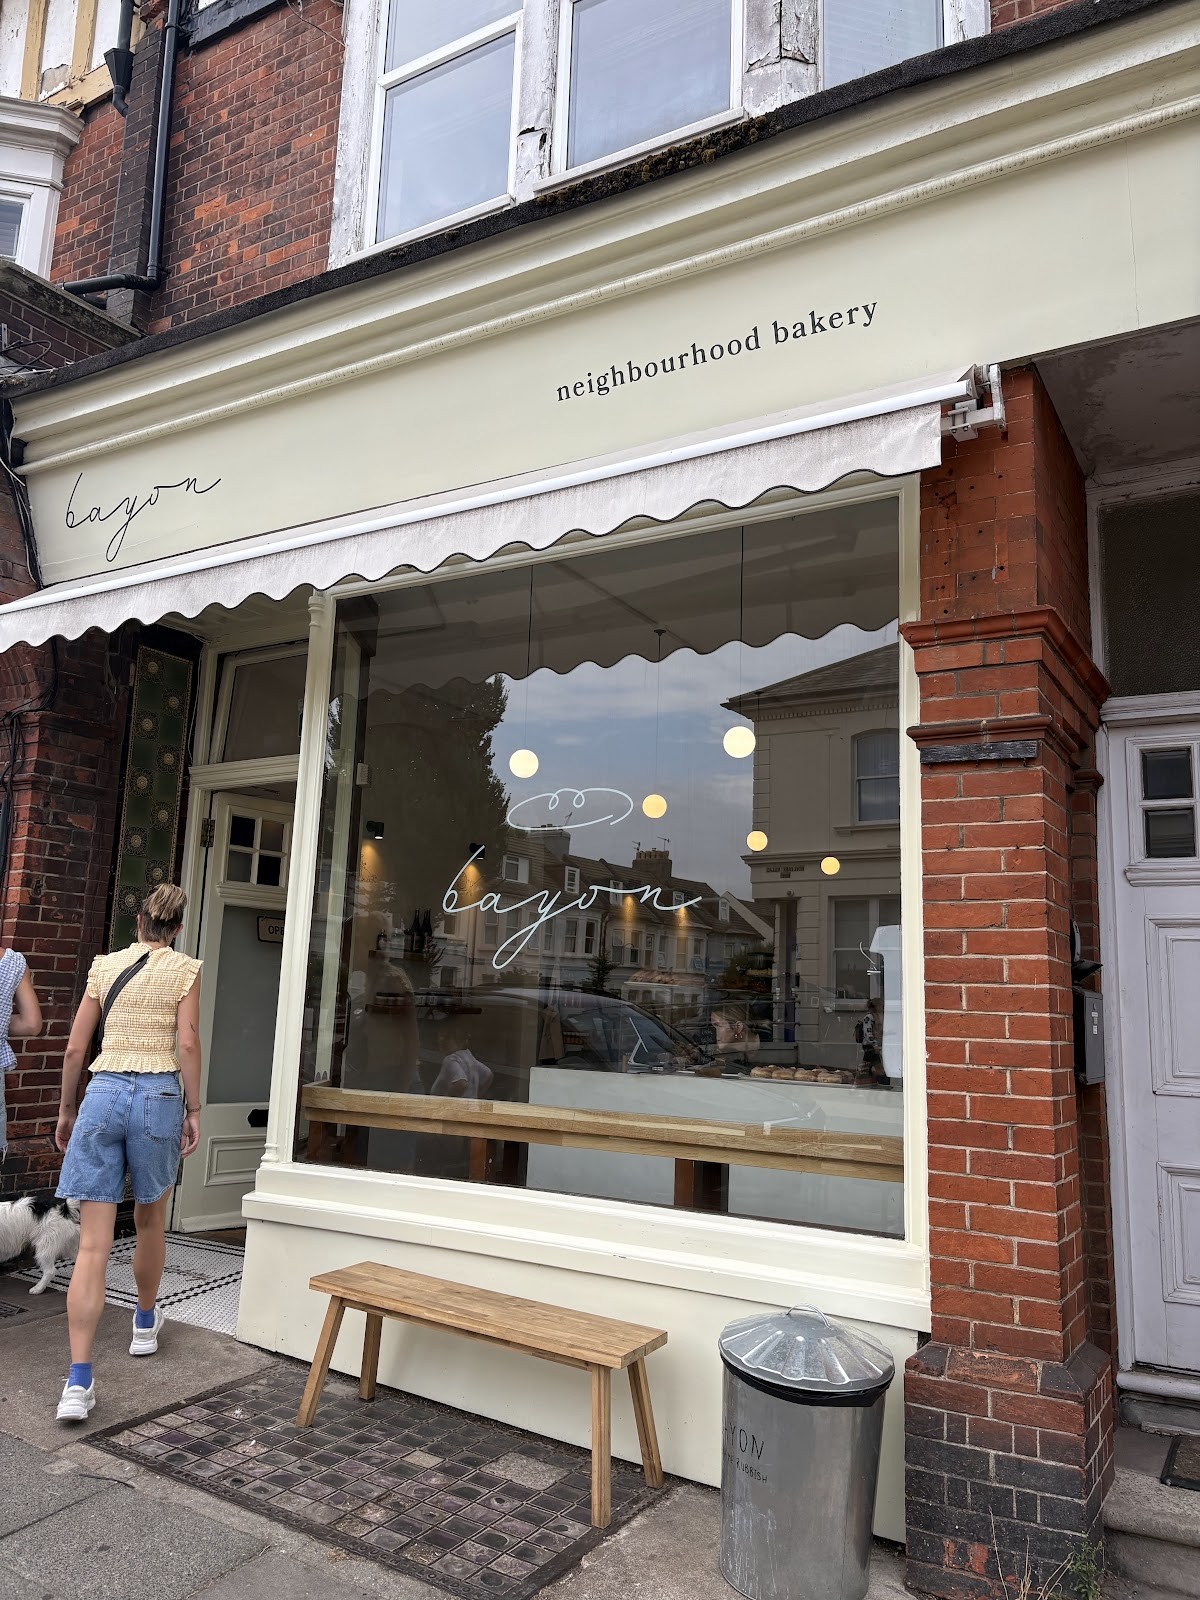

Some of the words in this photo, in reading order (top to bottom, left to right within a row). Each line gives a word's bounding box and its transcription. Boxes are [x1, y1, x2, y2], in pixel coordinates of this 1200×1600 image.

[556, 326, 762, 402] neighbourhood
[771, 301, 878, 345] bakery
[66, 472, 222, 562] bayon
[442, 844, 703, 970] bayon
[736, 1457, 768, 1483] RUBBISH
[325, 1532, 400, 1567] BOROUGH
